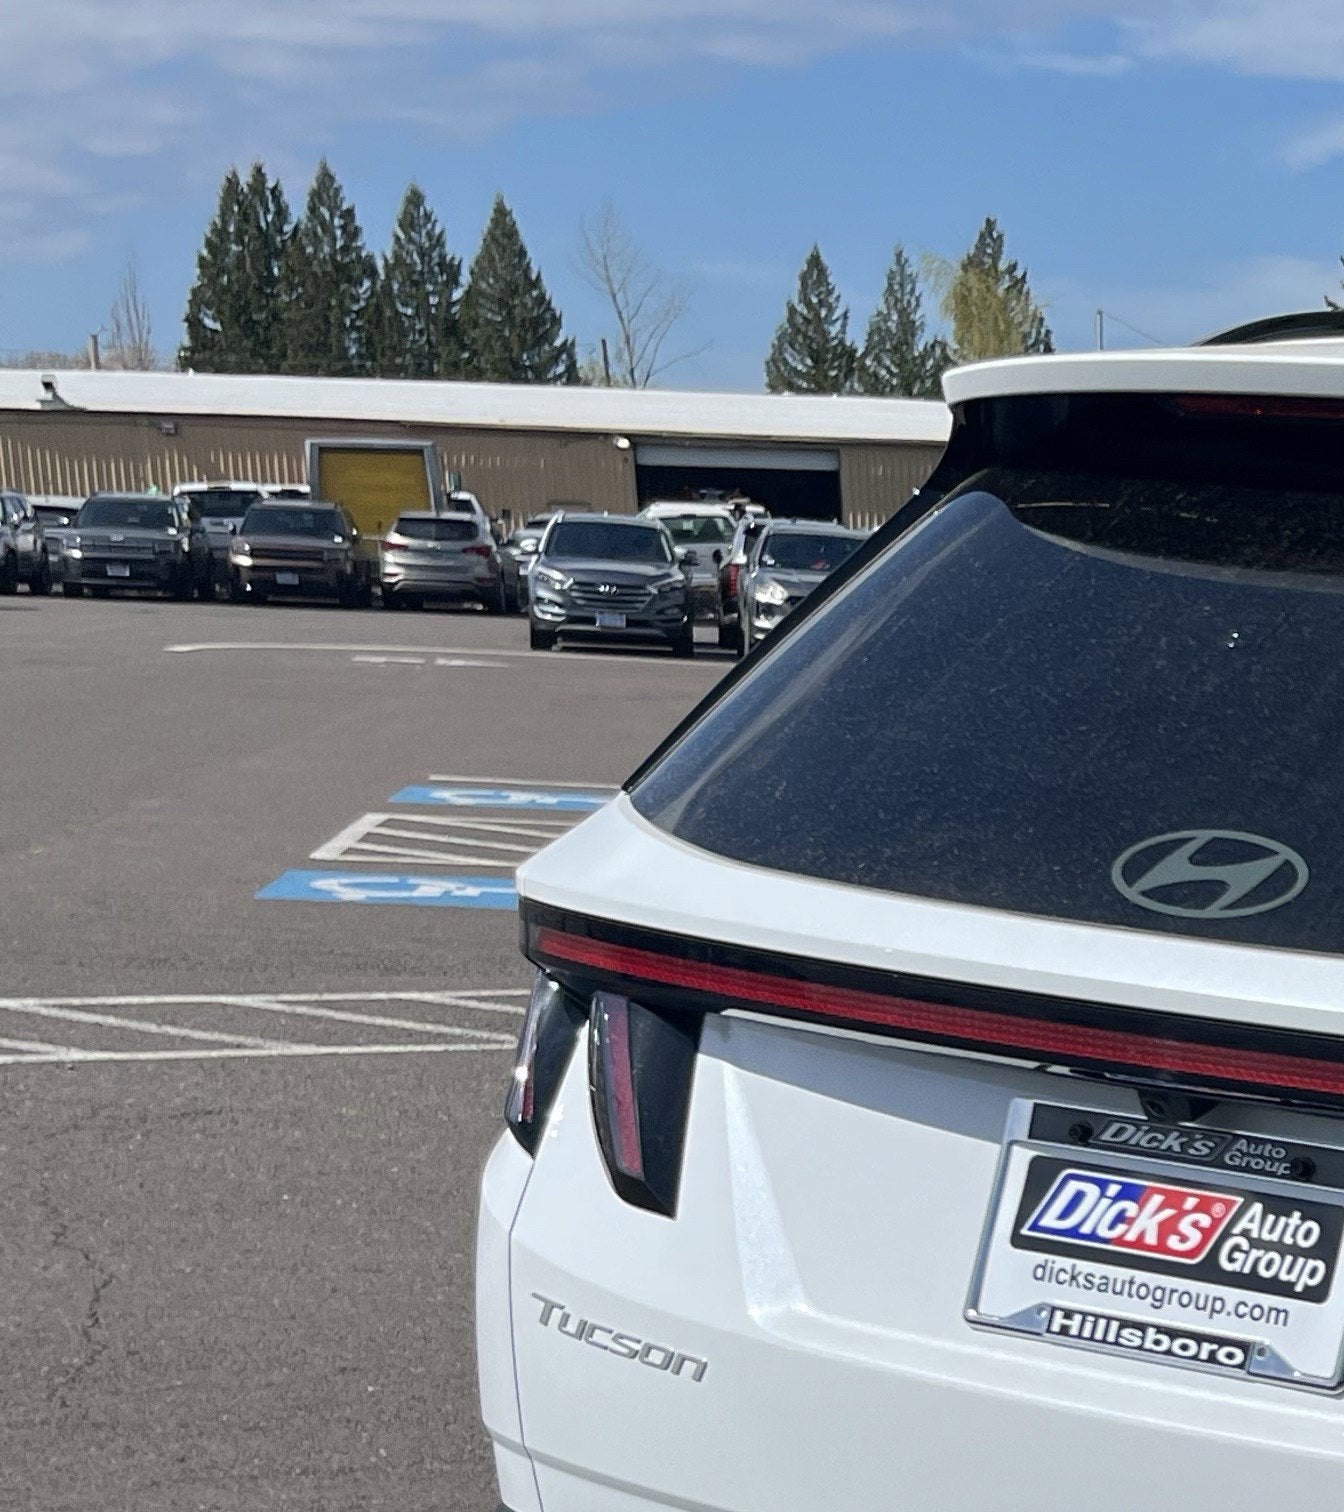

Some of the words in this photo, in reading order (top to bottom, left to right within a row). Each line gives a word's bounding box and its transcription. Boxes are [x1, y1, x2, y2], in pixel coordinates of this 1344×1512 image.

[1100, 1121, 1216, 1157] Dick's
[1223, 1150, 1292, 1176] Group
[1231, 1138, 1287, 1159] Auto
[1037, 1180, 1213, 1252] Dick's
[1233, 1201, 1321, 1249] Auto
[1218, 1237, 1327, 1292] Group
[1032, 1258, 1290, 1328] dicksautogroup.com
[1047, 1309, 1246, 1367] Hillsboro
